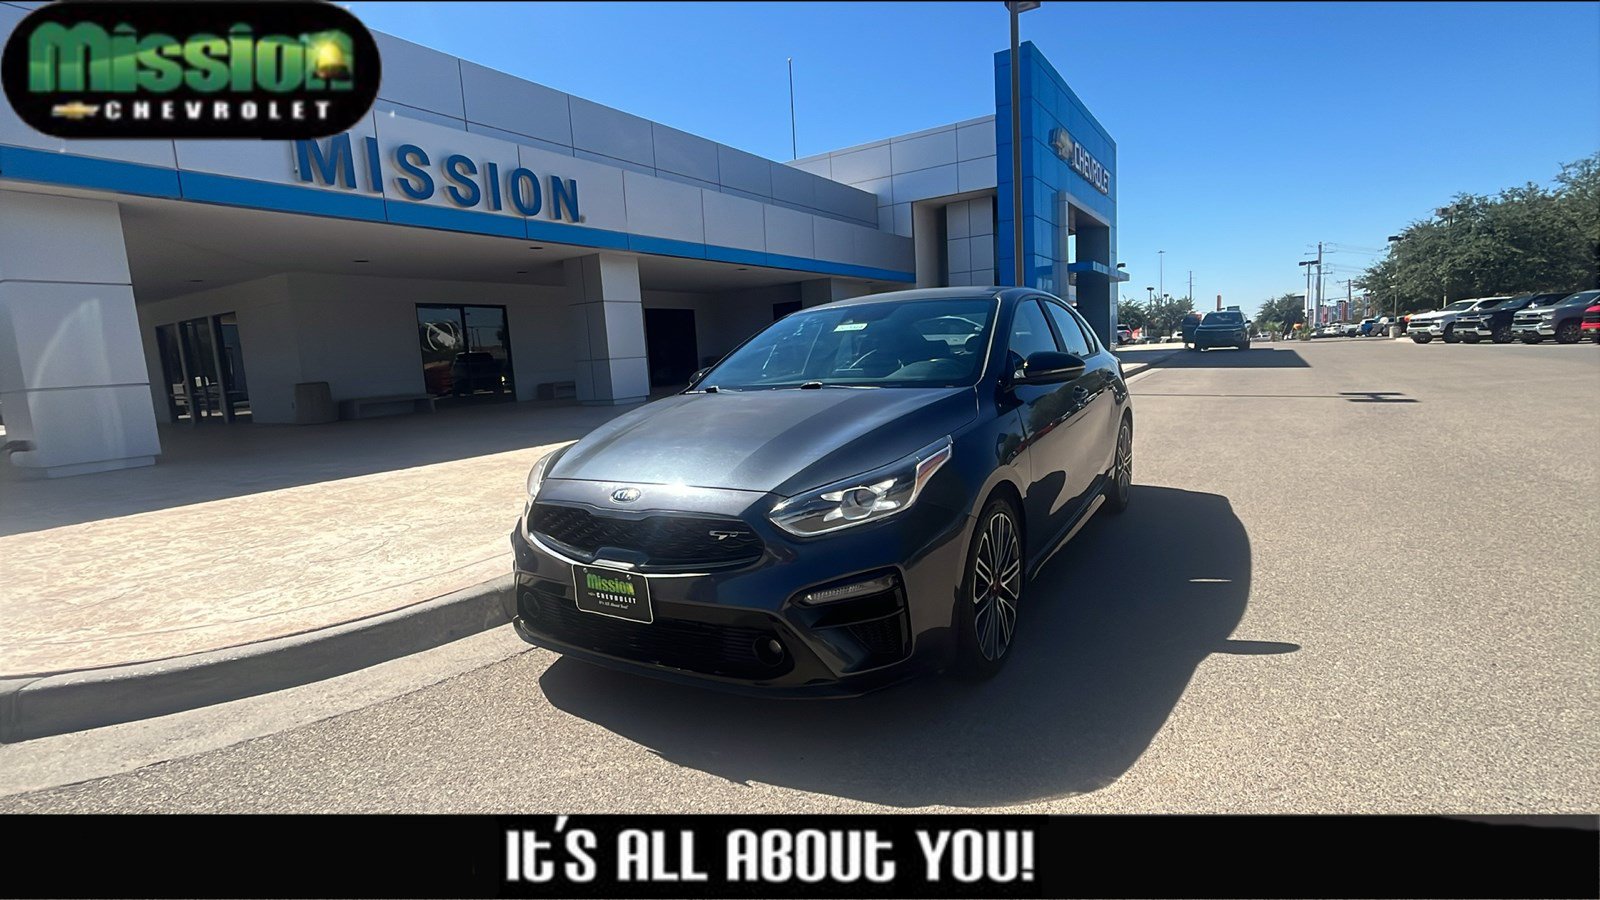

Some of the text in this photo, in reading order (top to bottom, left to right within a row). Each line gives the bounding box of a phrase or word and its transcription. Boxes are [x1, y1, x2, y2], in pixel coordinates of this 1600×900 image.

[295, 132, 581, 223] MISSION
[1074, 141, 1110, 195] CHEVROLET
[586, 573, 635, 596] Mission
[596, 592, 636, 604] CHEVROLET
